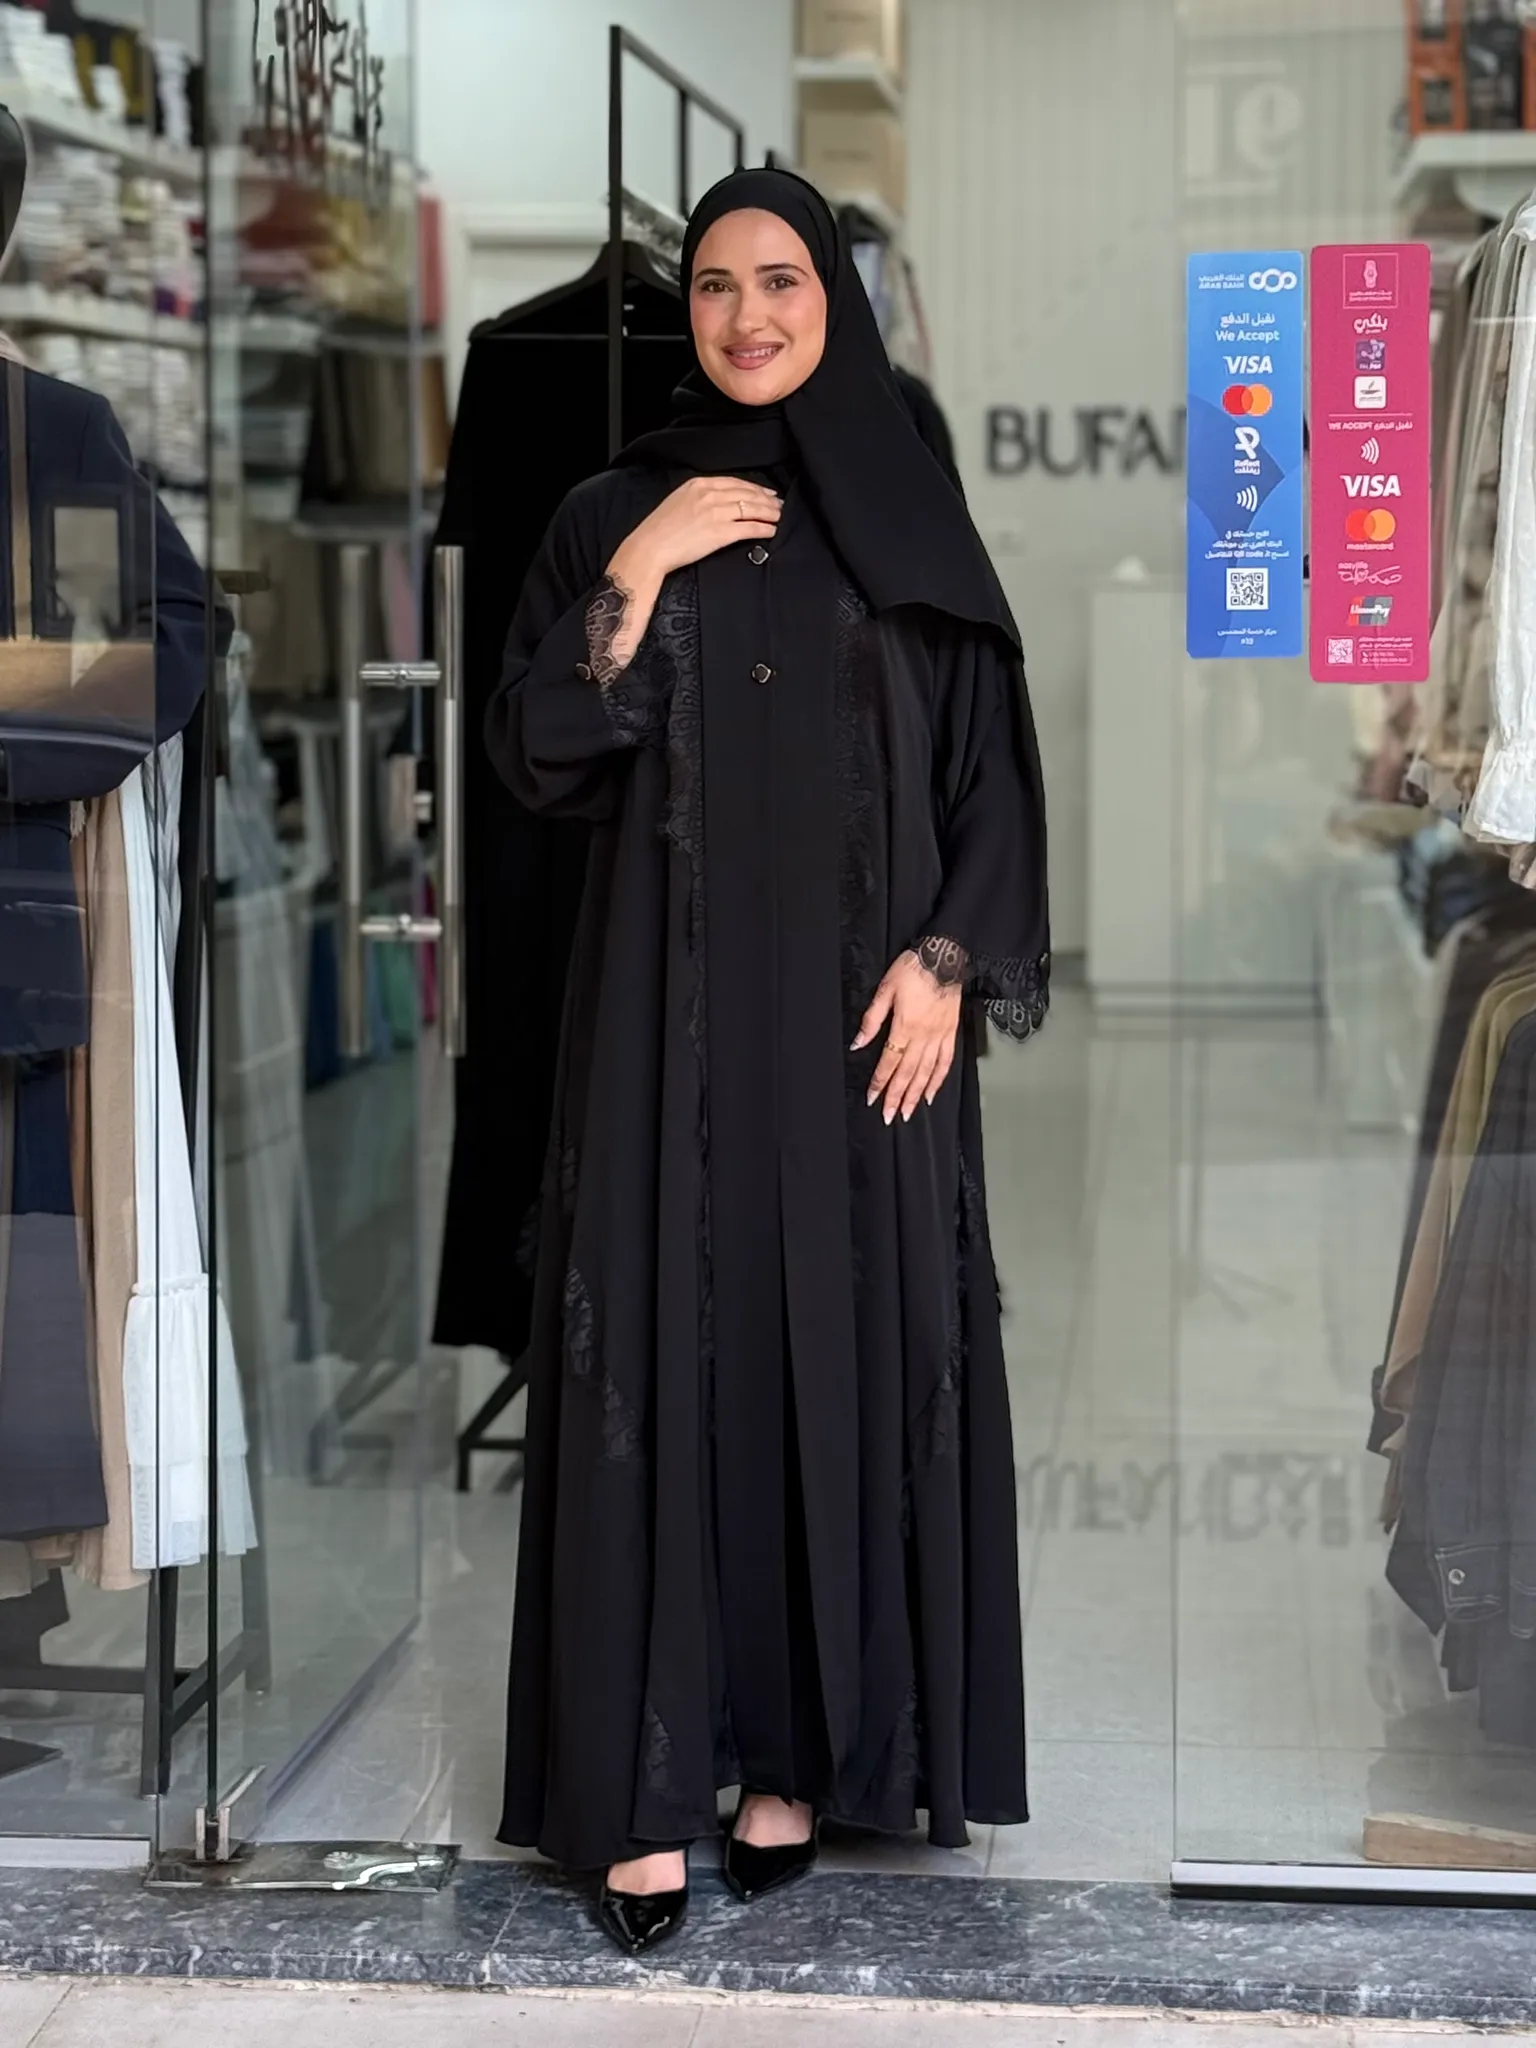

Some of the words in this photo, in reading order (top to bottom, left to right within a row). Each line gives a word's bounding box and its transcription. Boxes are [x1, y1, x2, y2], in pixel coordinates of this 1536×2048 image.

[1198, 281, 1221, 290] ARAB
[1222, 281, 1245, 289] BANK
[1220, 312, 1250, 328] الدفع
[1251, 312, 1275, 327] نقبل
[1215, 330, 1235, 342] We
[1236, 330, 1280, 344] Accept
[1222, 355, 1273, 374] VISA
[1342, 421, 1373, 431] ACCEPT
[1340, 475, 1401, 497] VISA
[1346, 543, 1394, 551] mastercard
